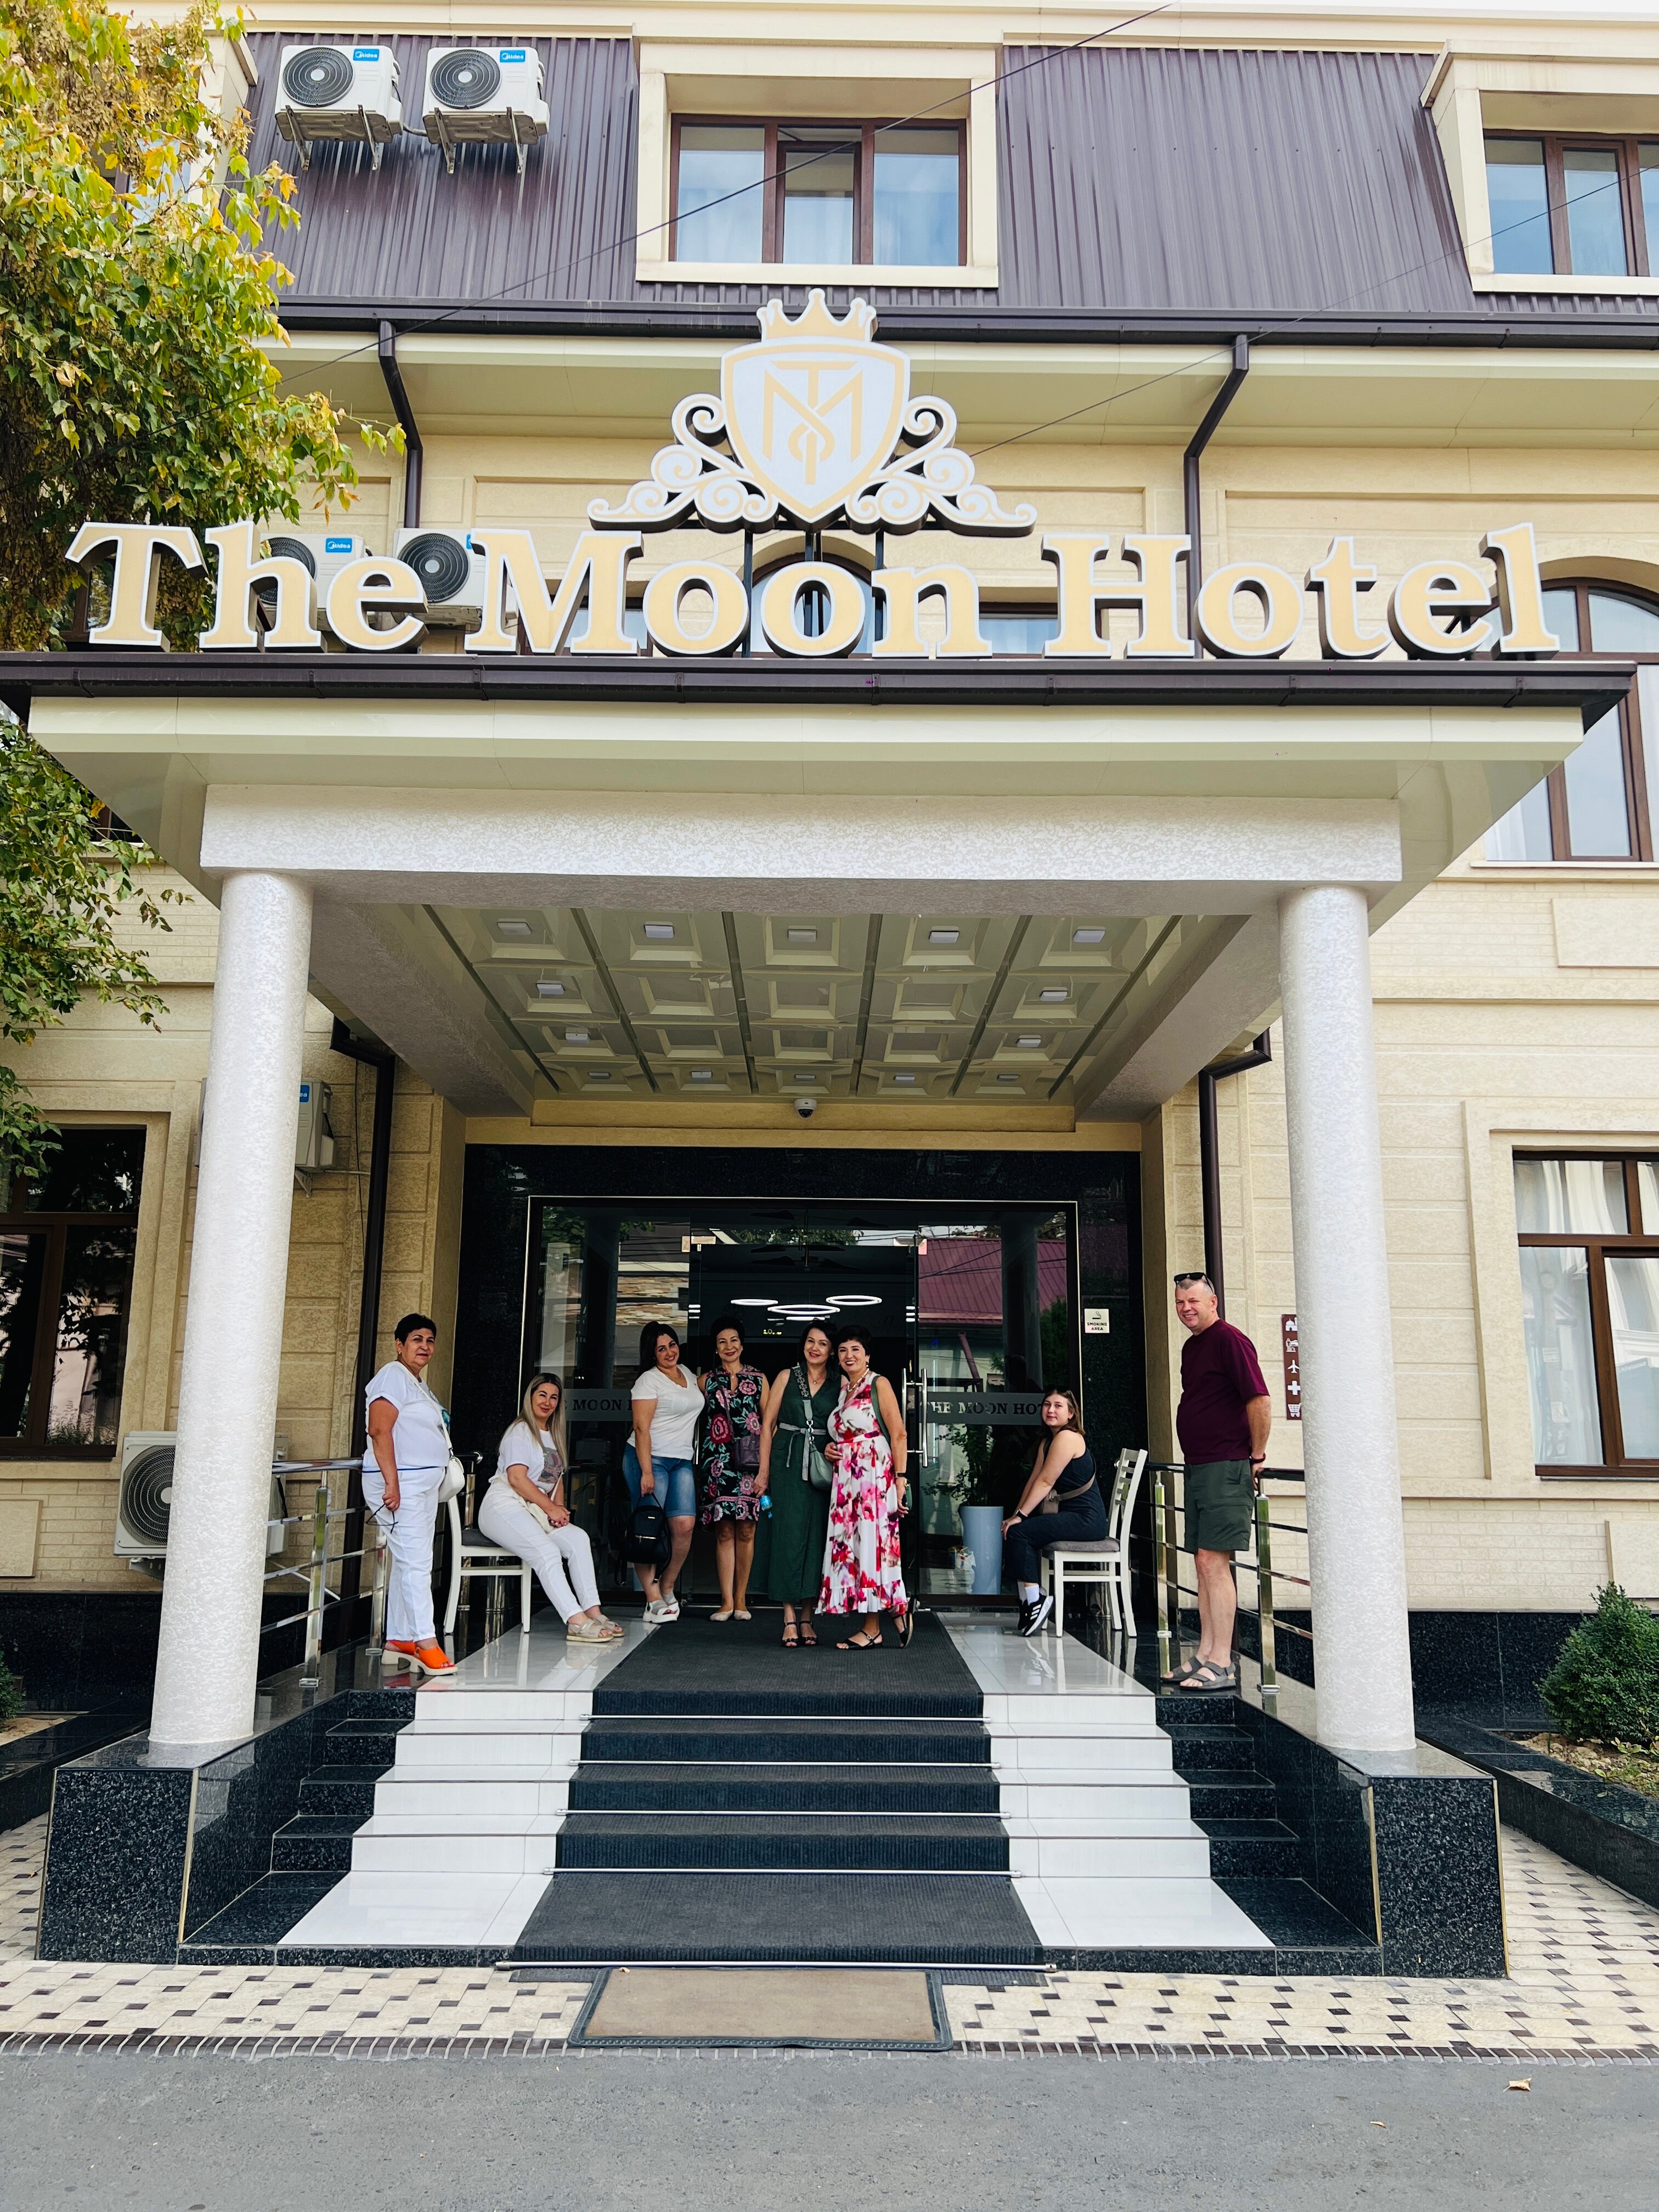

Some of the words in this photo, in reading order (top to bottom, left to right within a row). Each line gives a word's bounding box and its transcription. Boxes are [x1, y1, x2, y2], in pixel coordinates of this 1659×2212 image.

[328, 541, 351, 549] Midea
[65, 520, 427, 651] The
[464, 528, 993, 657] Moon
[1041, 522, 1560, 657] Hotel
[573, 1399, 622, 1410] MOON
[958, 1402, 1008, 1414] MOON
